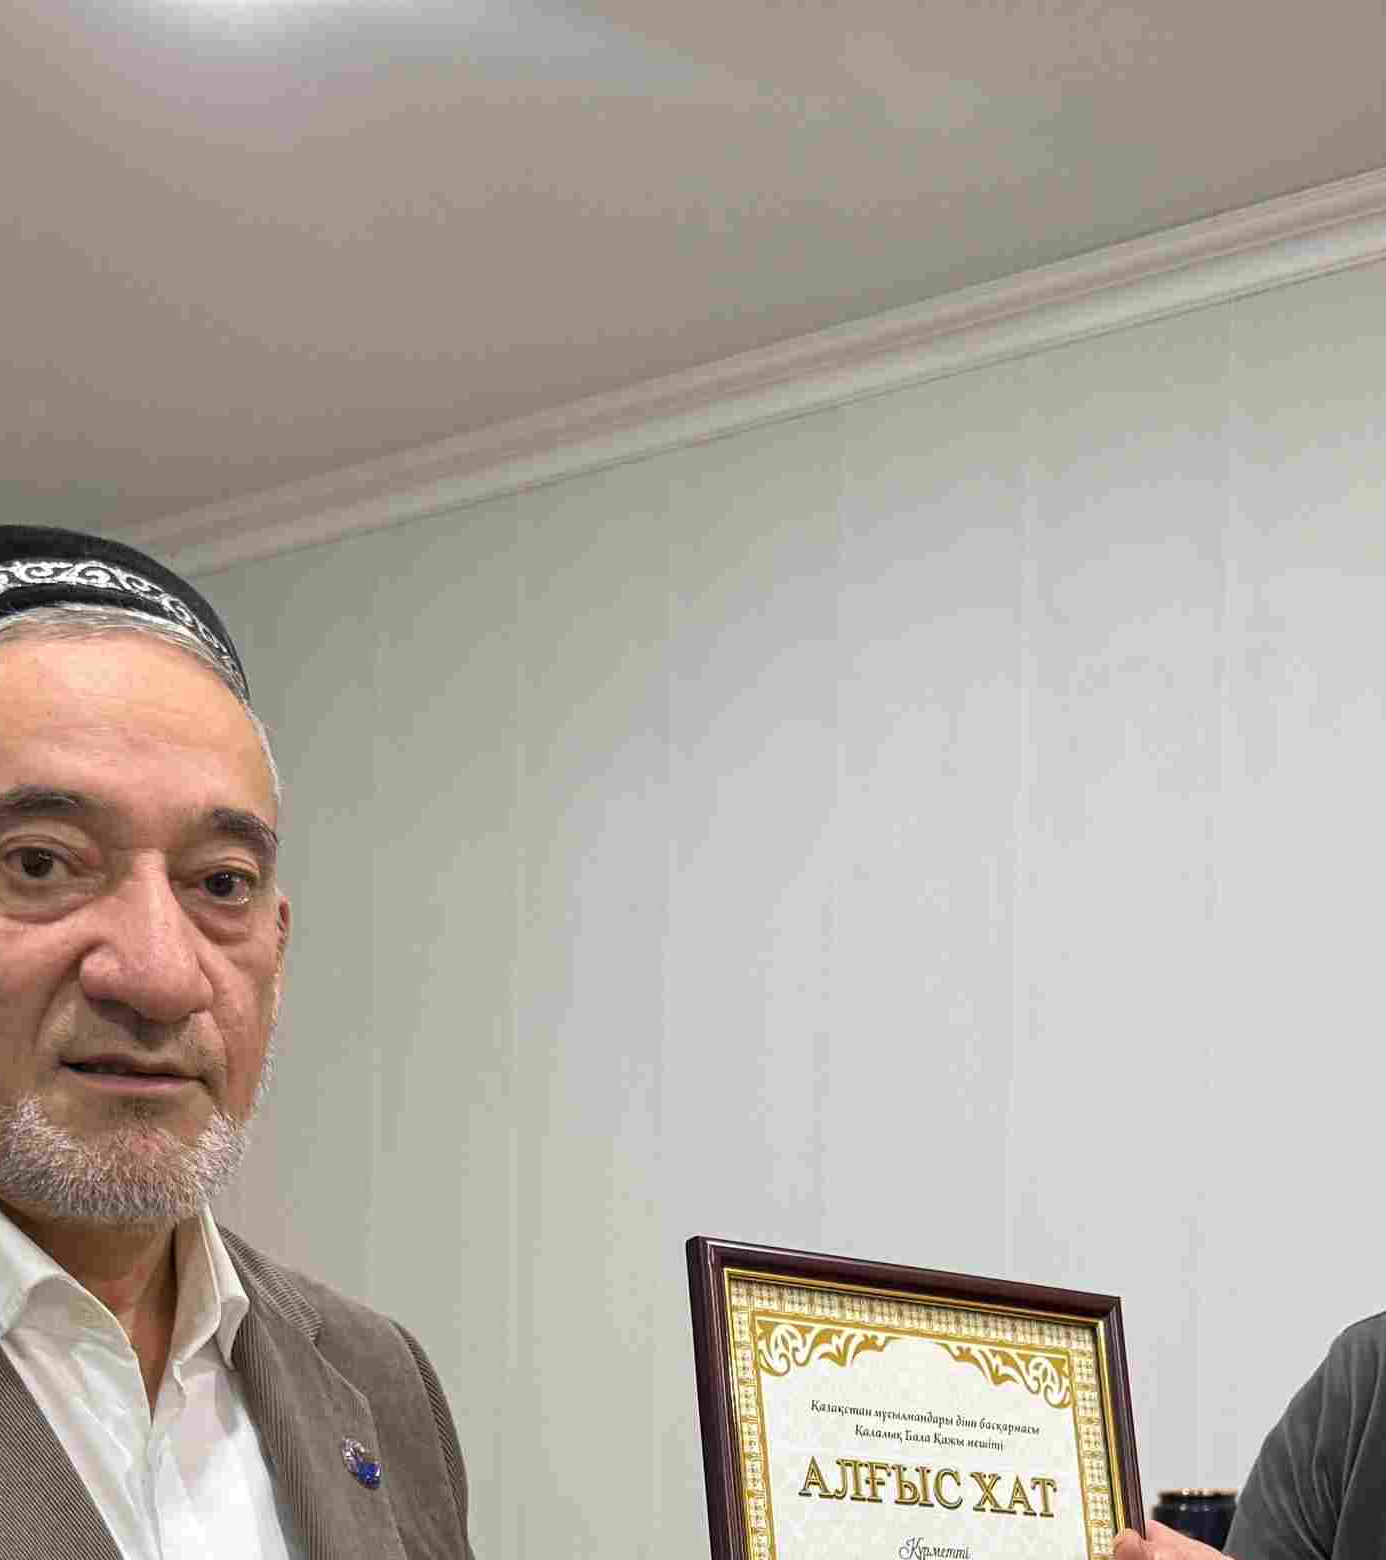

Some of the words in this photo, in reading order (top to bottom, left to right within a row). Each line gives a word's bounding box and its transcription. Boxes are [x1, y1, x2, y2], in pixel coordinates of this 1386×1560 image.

[810, 1399, 872, 1418] Қазақстан
[854, 1424, 903, 1444] Қалалық
[798, 1455, 964, 1510] АЛҒЫС
[969, 1471, 1058, 1518] ХАТ
